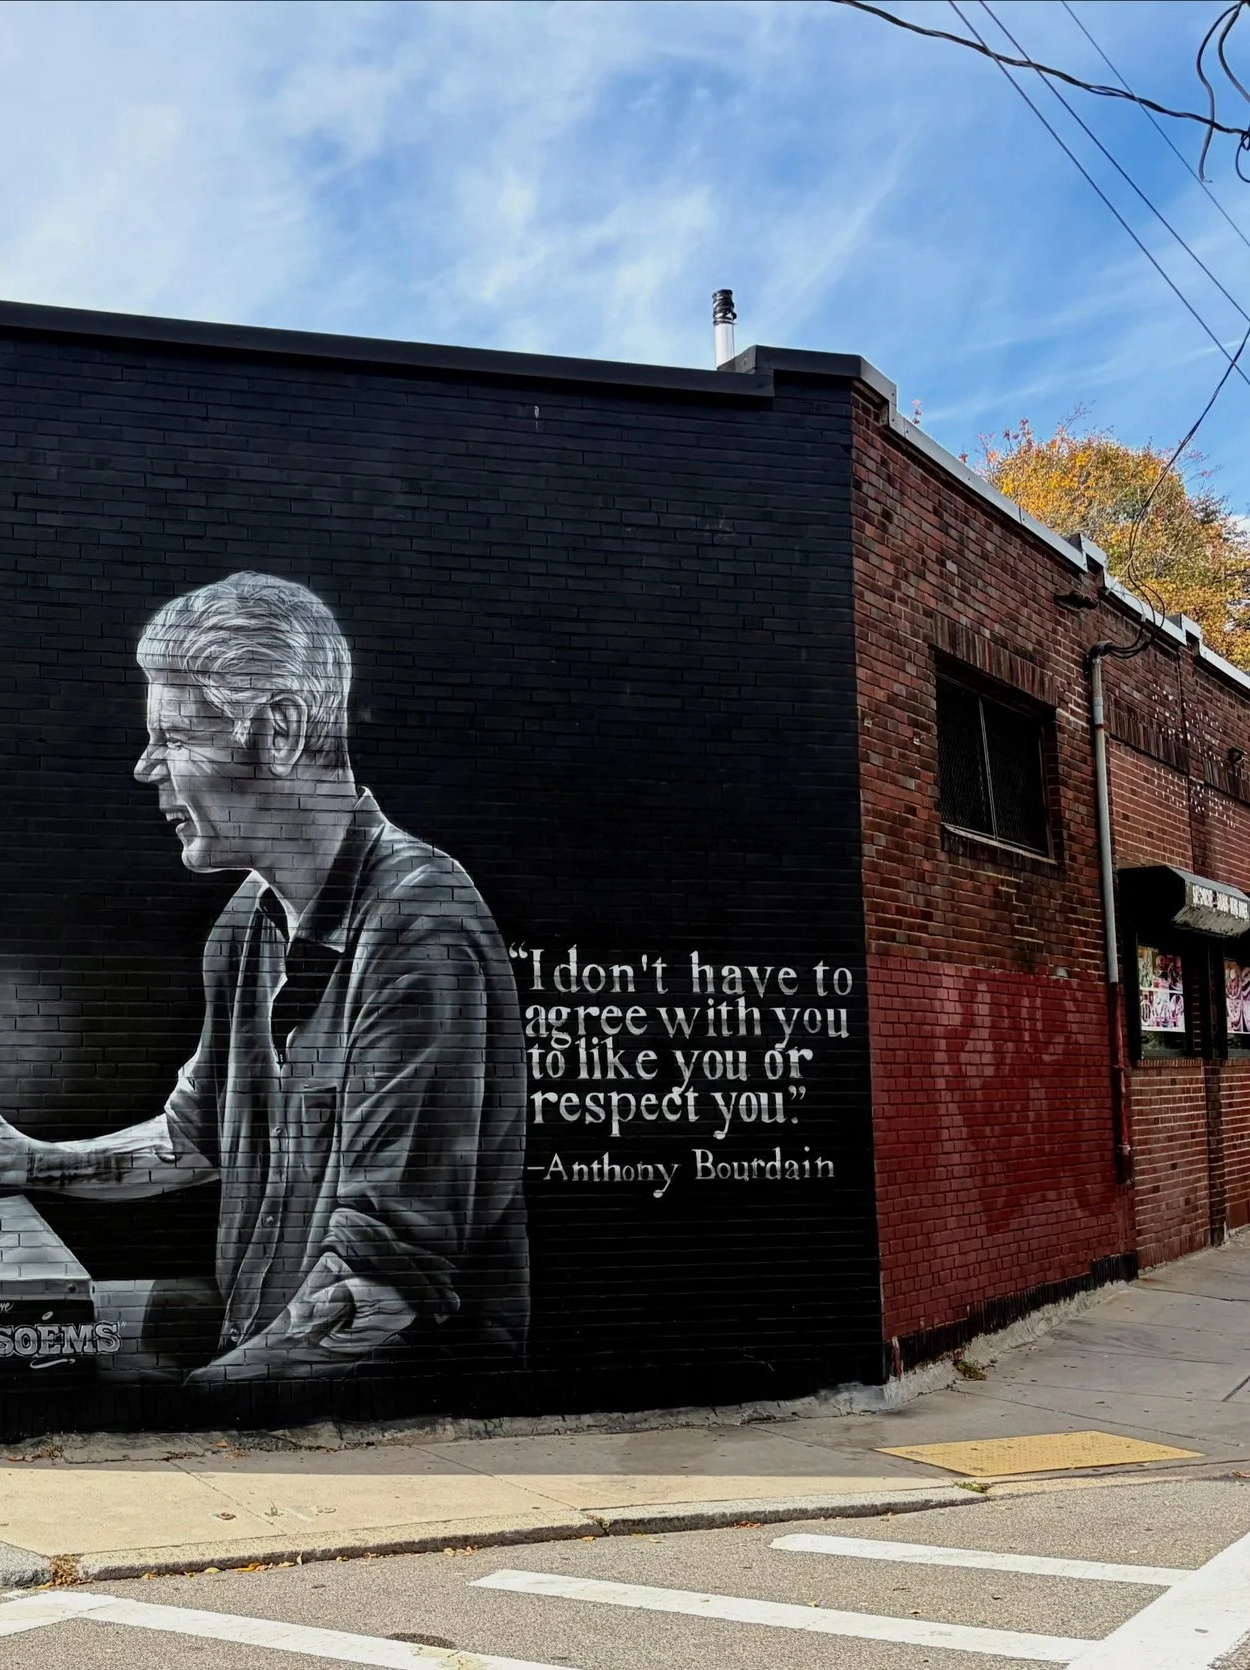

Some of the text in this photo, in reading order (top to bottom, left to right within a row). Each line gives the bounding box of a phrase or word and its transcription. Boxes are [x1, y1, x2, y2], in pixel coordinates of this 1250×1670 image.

[553, 943, 670, 996] don't
[689, 949, 800, 999] have
[811, 959, 854, 998] to
[524, 994, 851, 1050] agree with you
[525, 1034, 814, 1105] to like you or
[529, 1085, 701, 1138] respect
[691, 1144, 837, 1182] Bourdain
